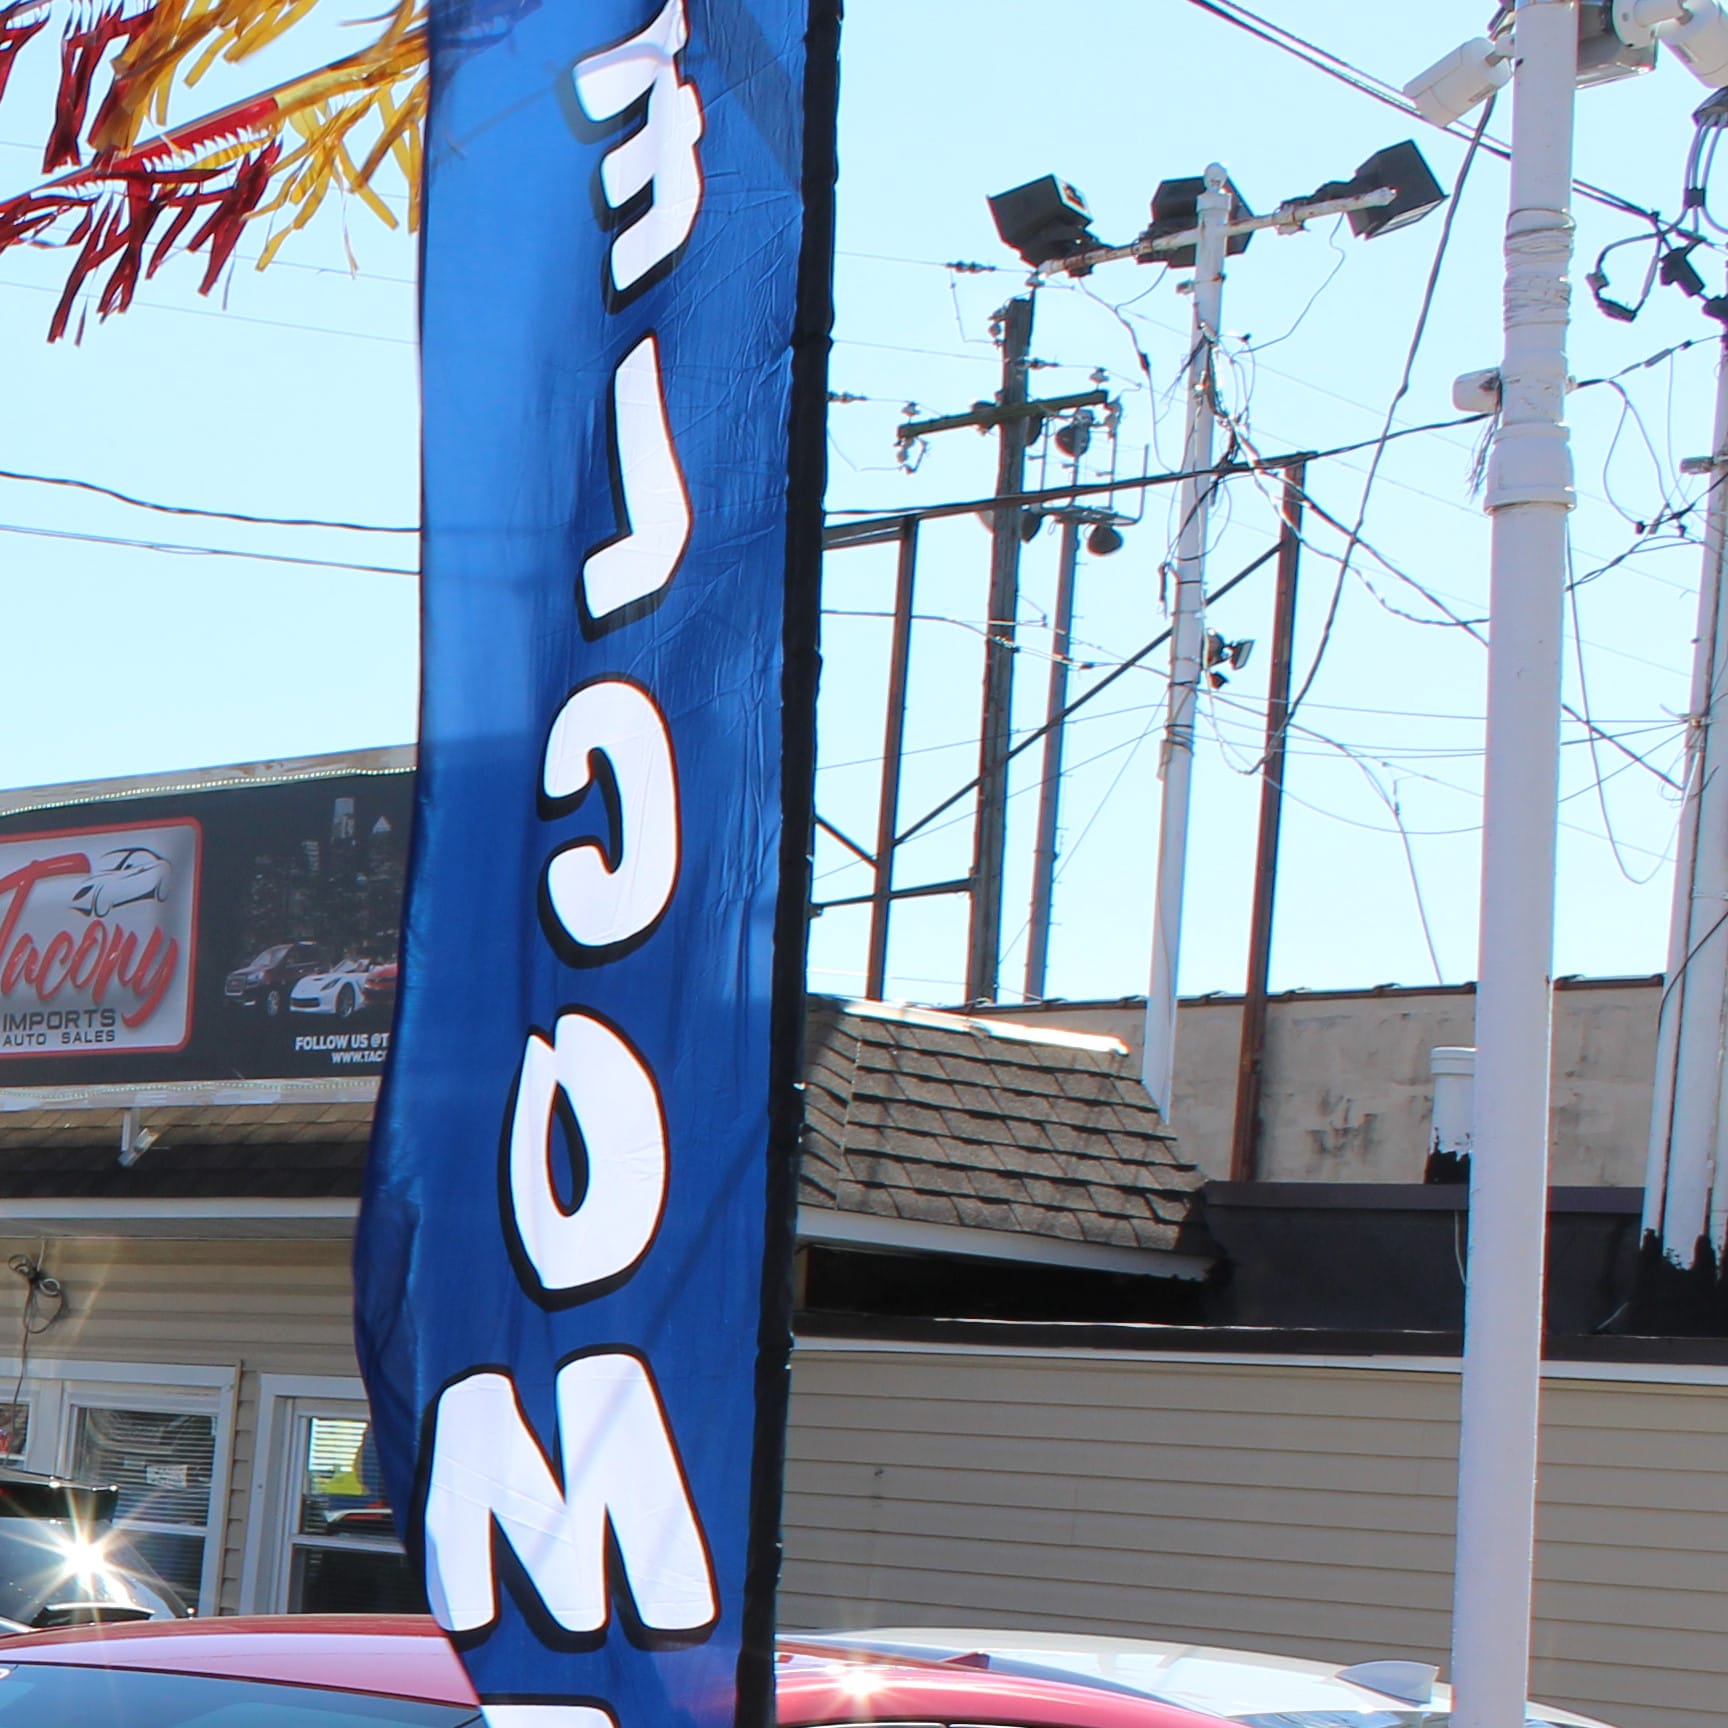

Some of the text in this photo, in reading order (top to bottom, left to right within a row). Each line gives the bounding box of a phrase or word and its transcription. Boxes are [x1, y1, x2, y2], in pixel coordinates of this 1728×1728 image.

[3, 1007, 116, 1032] IMPORTS
[2, 1029, 116, 1048] AUTO SALES
[295, 1033, 350, 1051] FOLLOW
[351, 1033, 369, 1048] US
